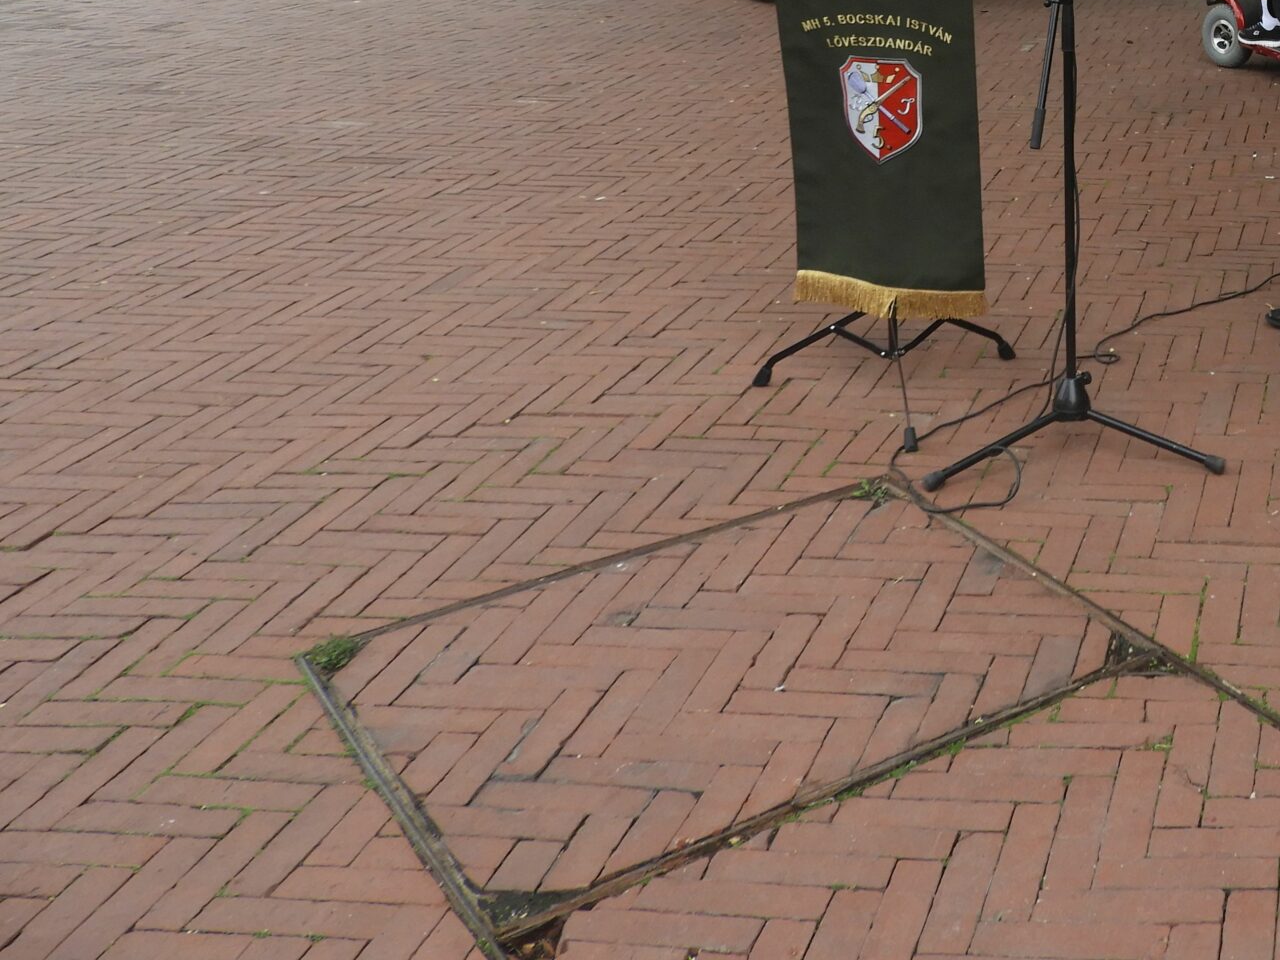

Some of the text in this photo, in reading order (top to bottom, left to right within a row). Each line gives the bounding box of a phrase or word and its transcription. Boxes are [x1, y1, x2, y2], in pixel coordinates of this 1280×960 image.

[801, 14, 953, 44] MH 5. BOCSKAI ISTVÁN
